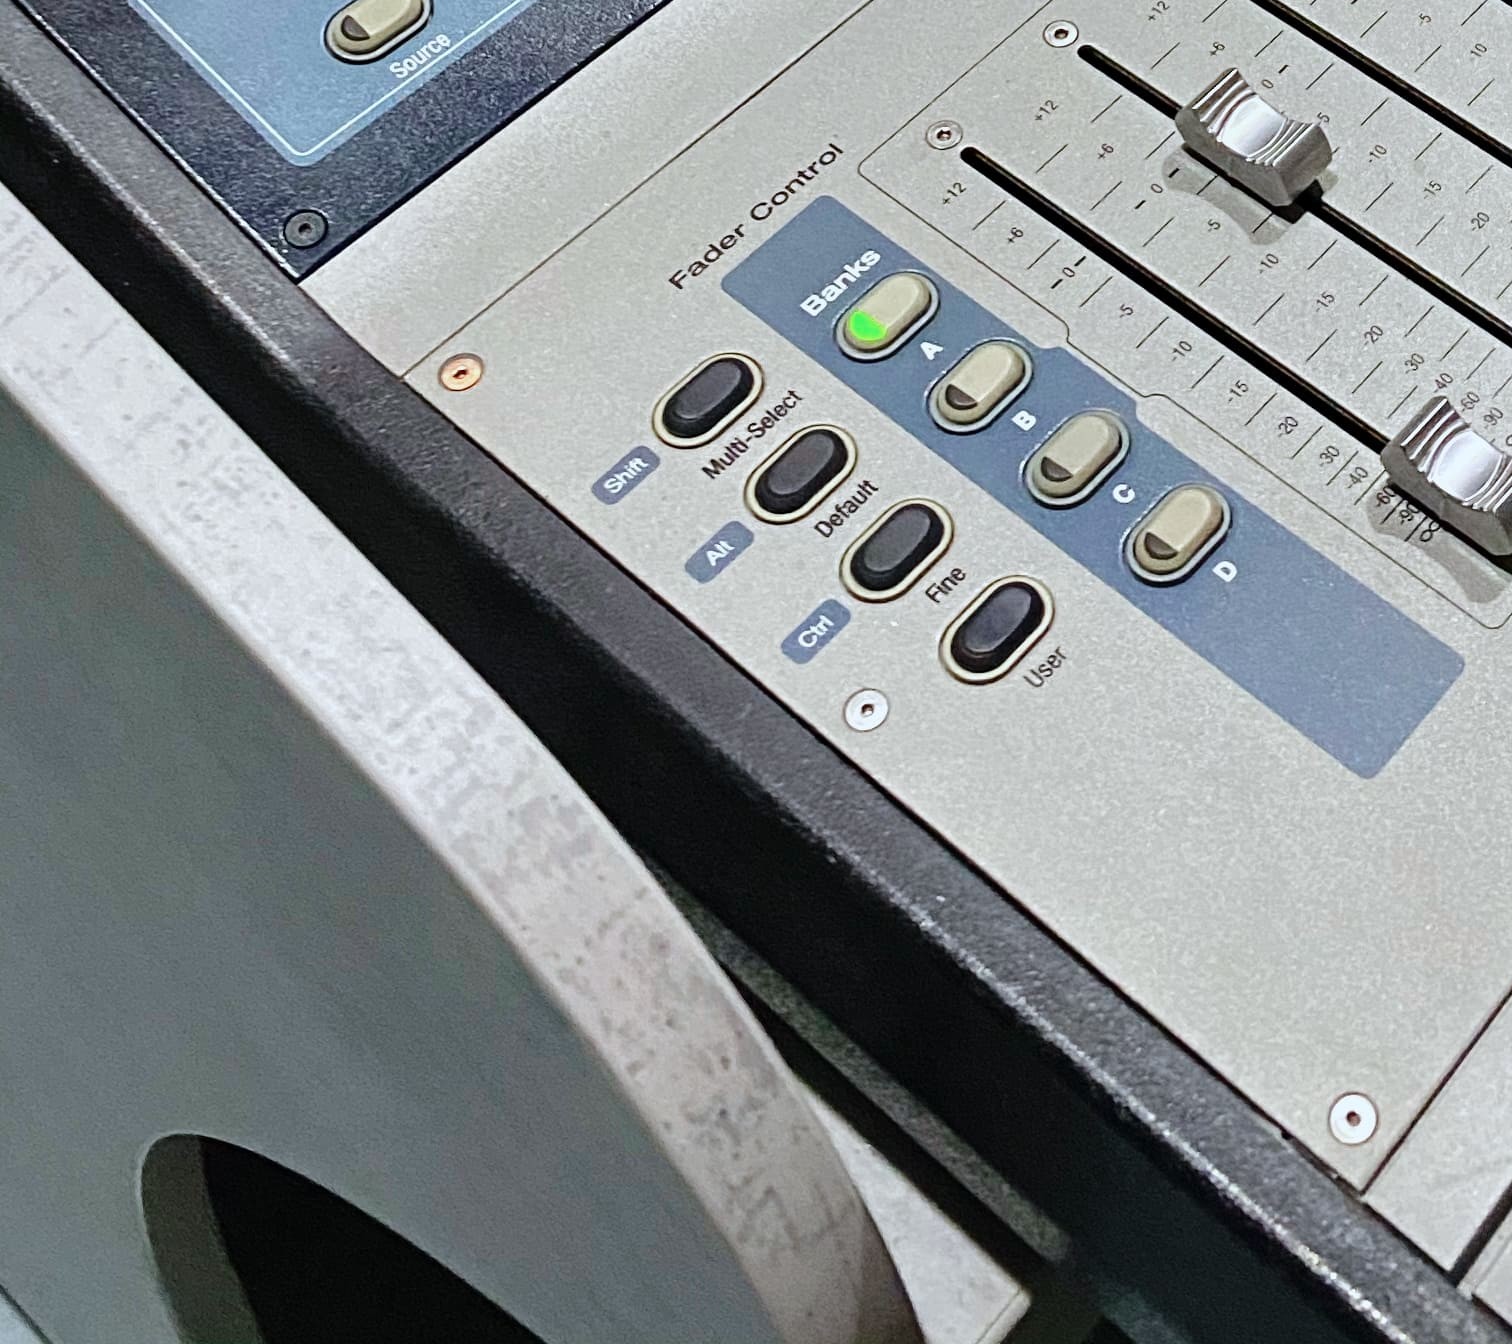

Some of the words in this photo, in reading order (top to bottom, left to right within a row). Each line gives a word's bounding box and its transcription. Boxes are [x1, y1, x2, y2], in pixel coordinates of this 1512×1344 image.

[1147, 0, 1171, 23] +12
[389, 32, 451, 81] Source
[941, 182, 967, 208] +12
[669, 221, 747, 292] Fader
[750, 143, 844, 224] Control
[1470, 211, 1491, 233] -20
[1006, 225, 1026, 245] +6
[799, 247, 883, 319] Banks
[920, 341, 944, 361] A
[1172, 340, 1194, 364] -10
[1227, 380, 1250, 404] -15
[1011, 409, 1036, 432] B
[1277, 415, 1300, 438] -20
[702, 388, 803, 482] Multi-Select
[1319, 445, 1341, 467] -30
[603, 456, 650, 499] Shift
[1347, 466, 1370, 489] -40
[1112, 482, 1137, 505] C
[814, 479, 879, 540] Default
[704, 535, 735, 566] Alt
[1212, 560, 1238, 582] D
[926, 564, 967, 605] Fine
[797, 614, 836, 652] Ctrl
[1024, 645, 1069, 691] User
